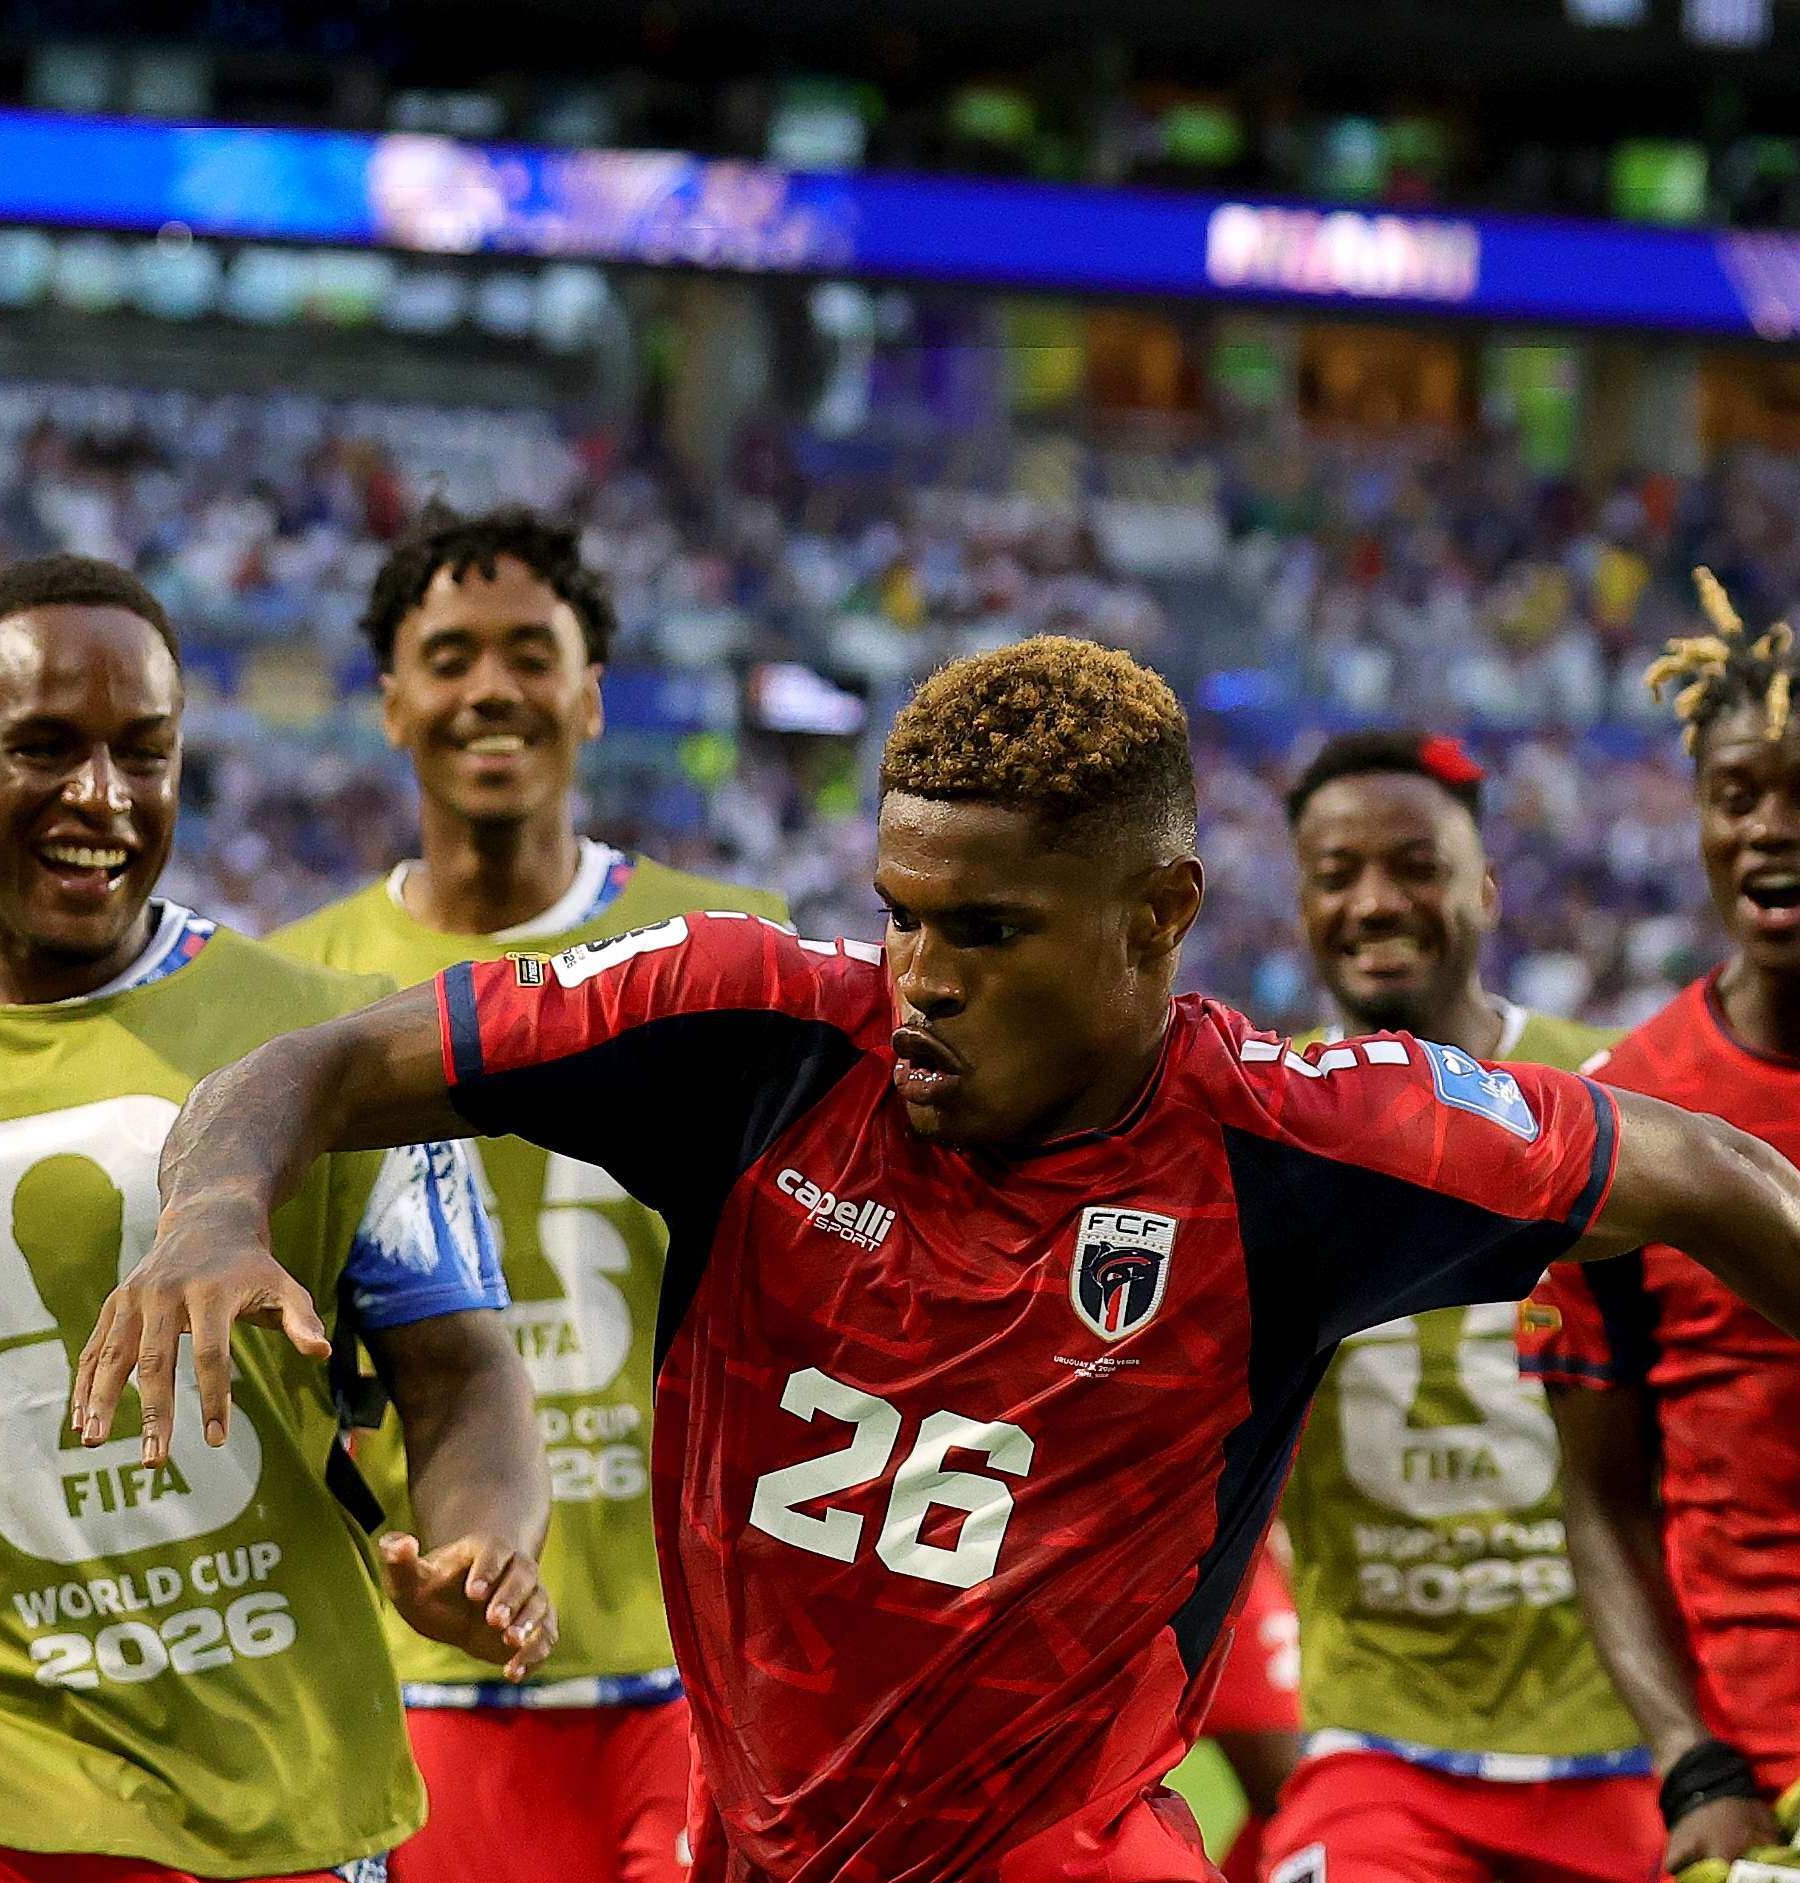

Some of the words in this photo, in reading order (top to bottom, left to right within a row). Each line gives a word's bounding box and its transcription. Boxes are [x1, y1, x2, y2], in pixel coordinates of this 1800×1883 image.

[777, 1168, 896, 1243] capelli
[813, 1216, 881, 1252] SPORT
[1087, 1212, 1169, 1237] FCF
[513, 1320, 581, 1359] IFA
[61, 1457, 192, 1519] FIFA
[547, 1445, 647, 1503] 26
[749, 1366, 1035, 1589] 26
[11, 1566, 183, 1630] WORLD
[190, 1540, 283, 1595] CUP
[30, 1591, 298, 1690] 2026
